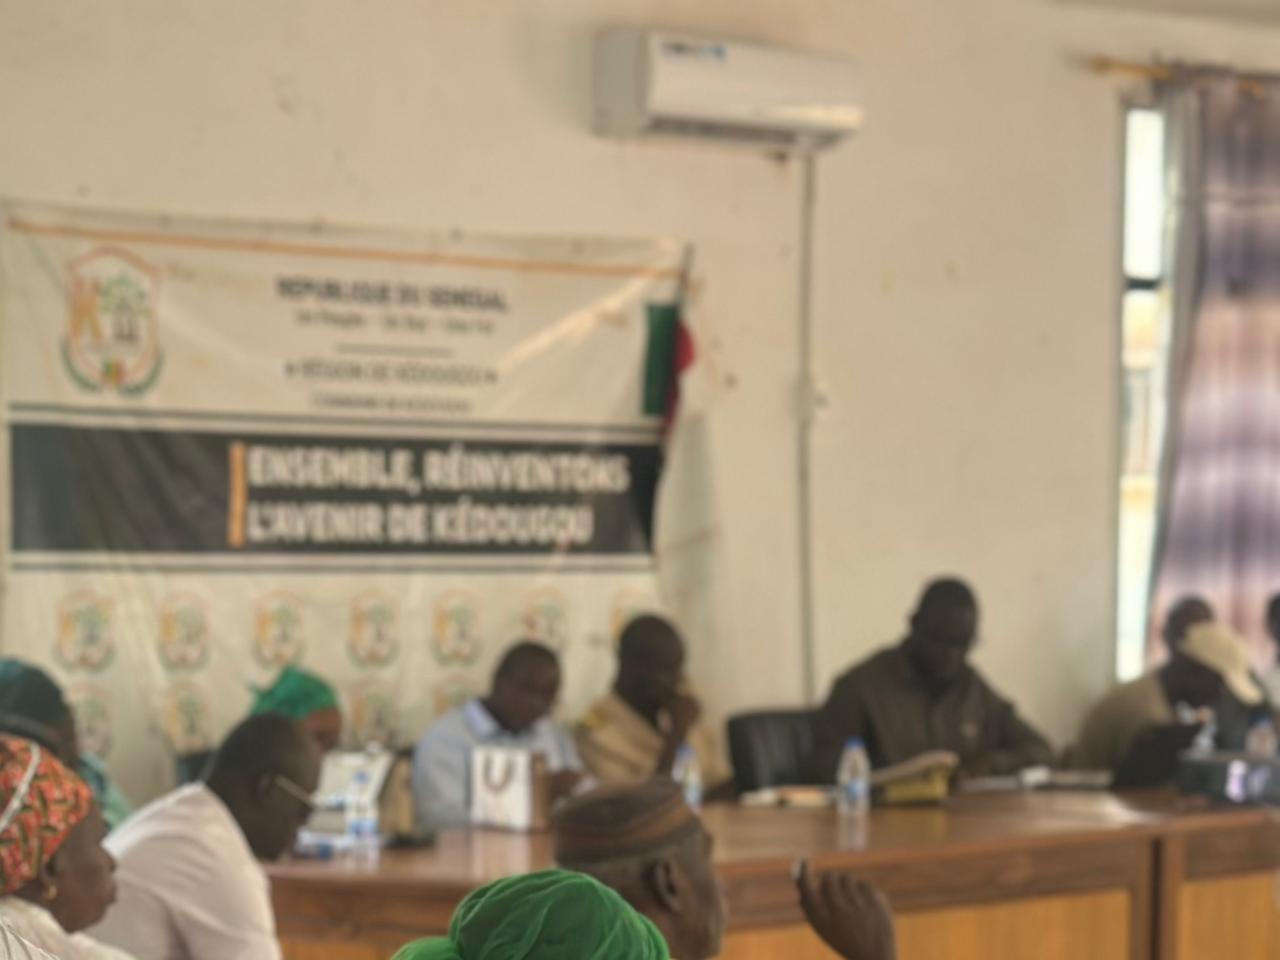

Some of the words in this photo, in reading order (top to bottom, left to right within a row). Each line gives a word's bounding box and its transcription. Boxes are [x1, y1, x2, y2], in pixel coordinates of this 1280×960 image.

[248, 445, 419, 496] ENSEMBLE,
[423, 441, 631, 493] RÉINVENTONS
[387, 504, 428, 543] DE
[432, 495, 595, 545] KÉDOUGOU
